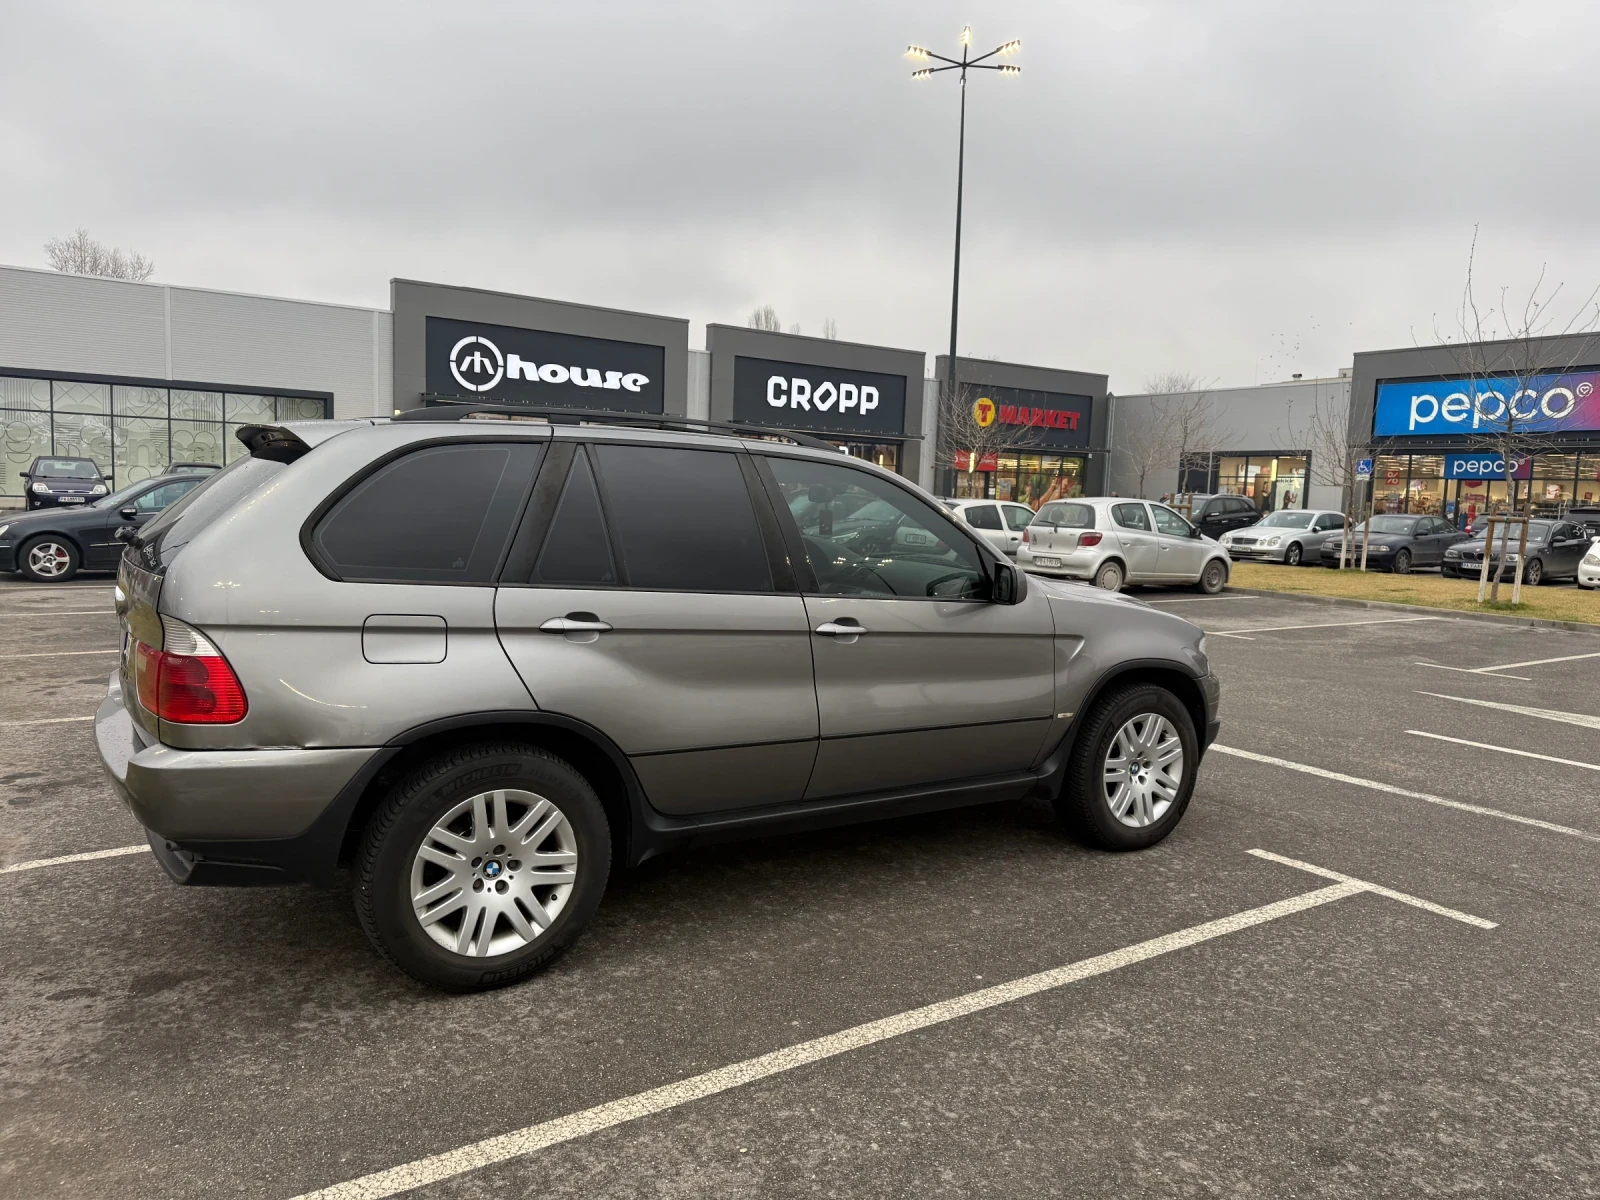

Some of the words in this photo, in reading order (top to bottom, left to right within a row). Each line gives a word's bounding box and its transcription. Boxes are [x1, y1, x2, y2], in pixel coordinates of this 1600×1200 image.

[506, 353, 650, 393] house
[766, 375, 880, 415] CROPP
[1408, 386, 1576, 431] pepco
[978, 403, 992, 423] T
[999, 404, 1081, 430] MARKET
[1453, 459, 1519, 475] pepco
[441, 763, 519, 797] MICHELIN
